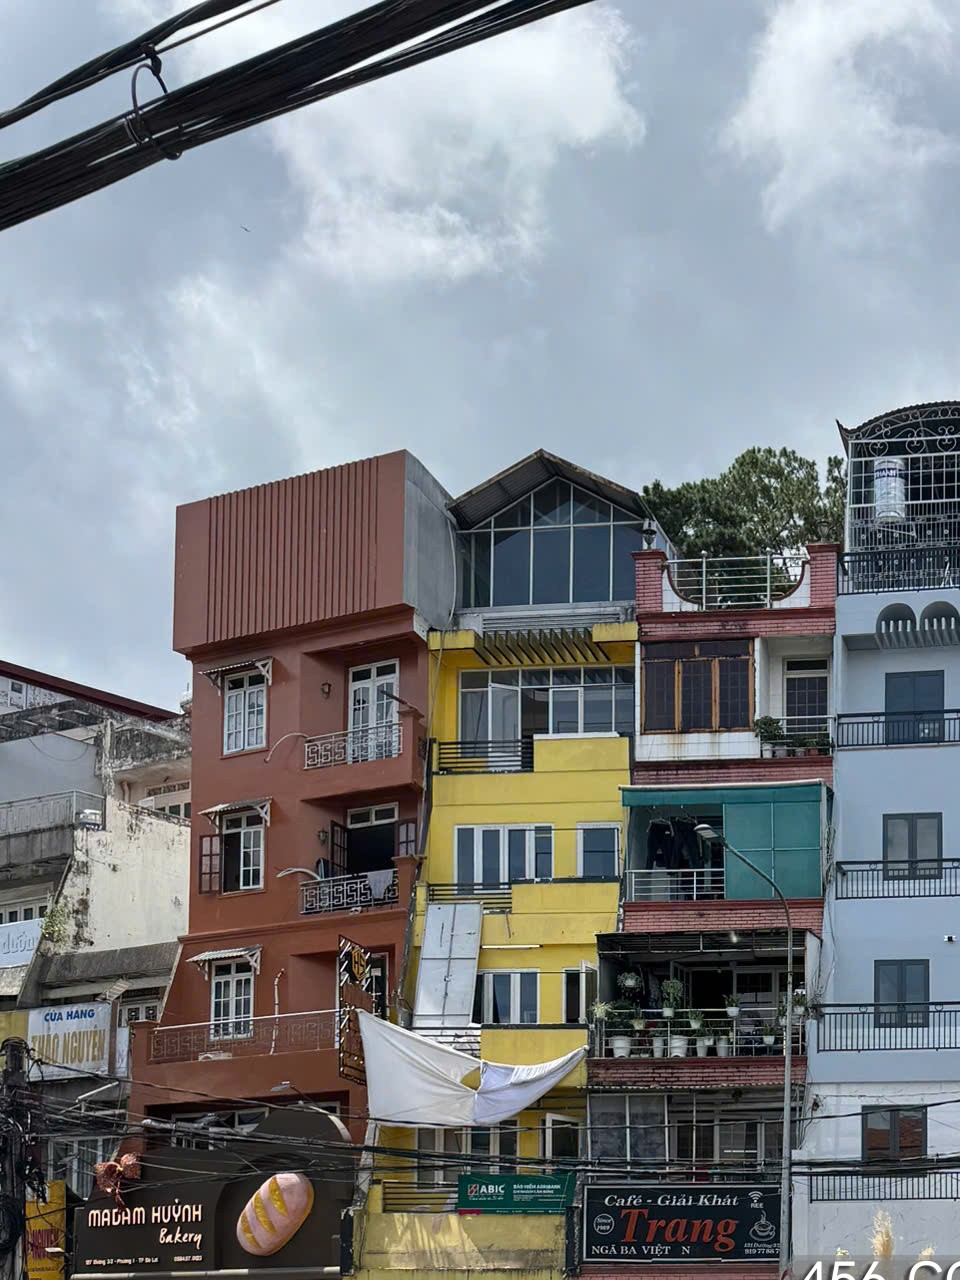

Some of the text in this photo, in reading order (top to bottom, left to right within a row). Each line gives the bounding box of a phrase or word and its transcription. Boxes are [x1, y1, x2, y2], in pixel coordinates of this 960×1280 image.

[44, 1007, 95, 1022] CỬA HÀNG
[480, 1184, 506, 1194] ABIC
[604, 1194, 643, 1207] Café
[657, 1194, 693, 1206] Giải
[697, 1194, 740, 1206] Khát
[88, 1198, 202, 1227] MADAM HUỲNH
[159, 1226, 202, 1249] Bakery
[620, 1209, 740, 1252] Trang
[591, 1244, 618, 1255] NGÃ
[620, 1245, 637, 1255] BA
[641, 1243, 671, 1257] VIỆT
